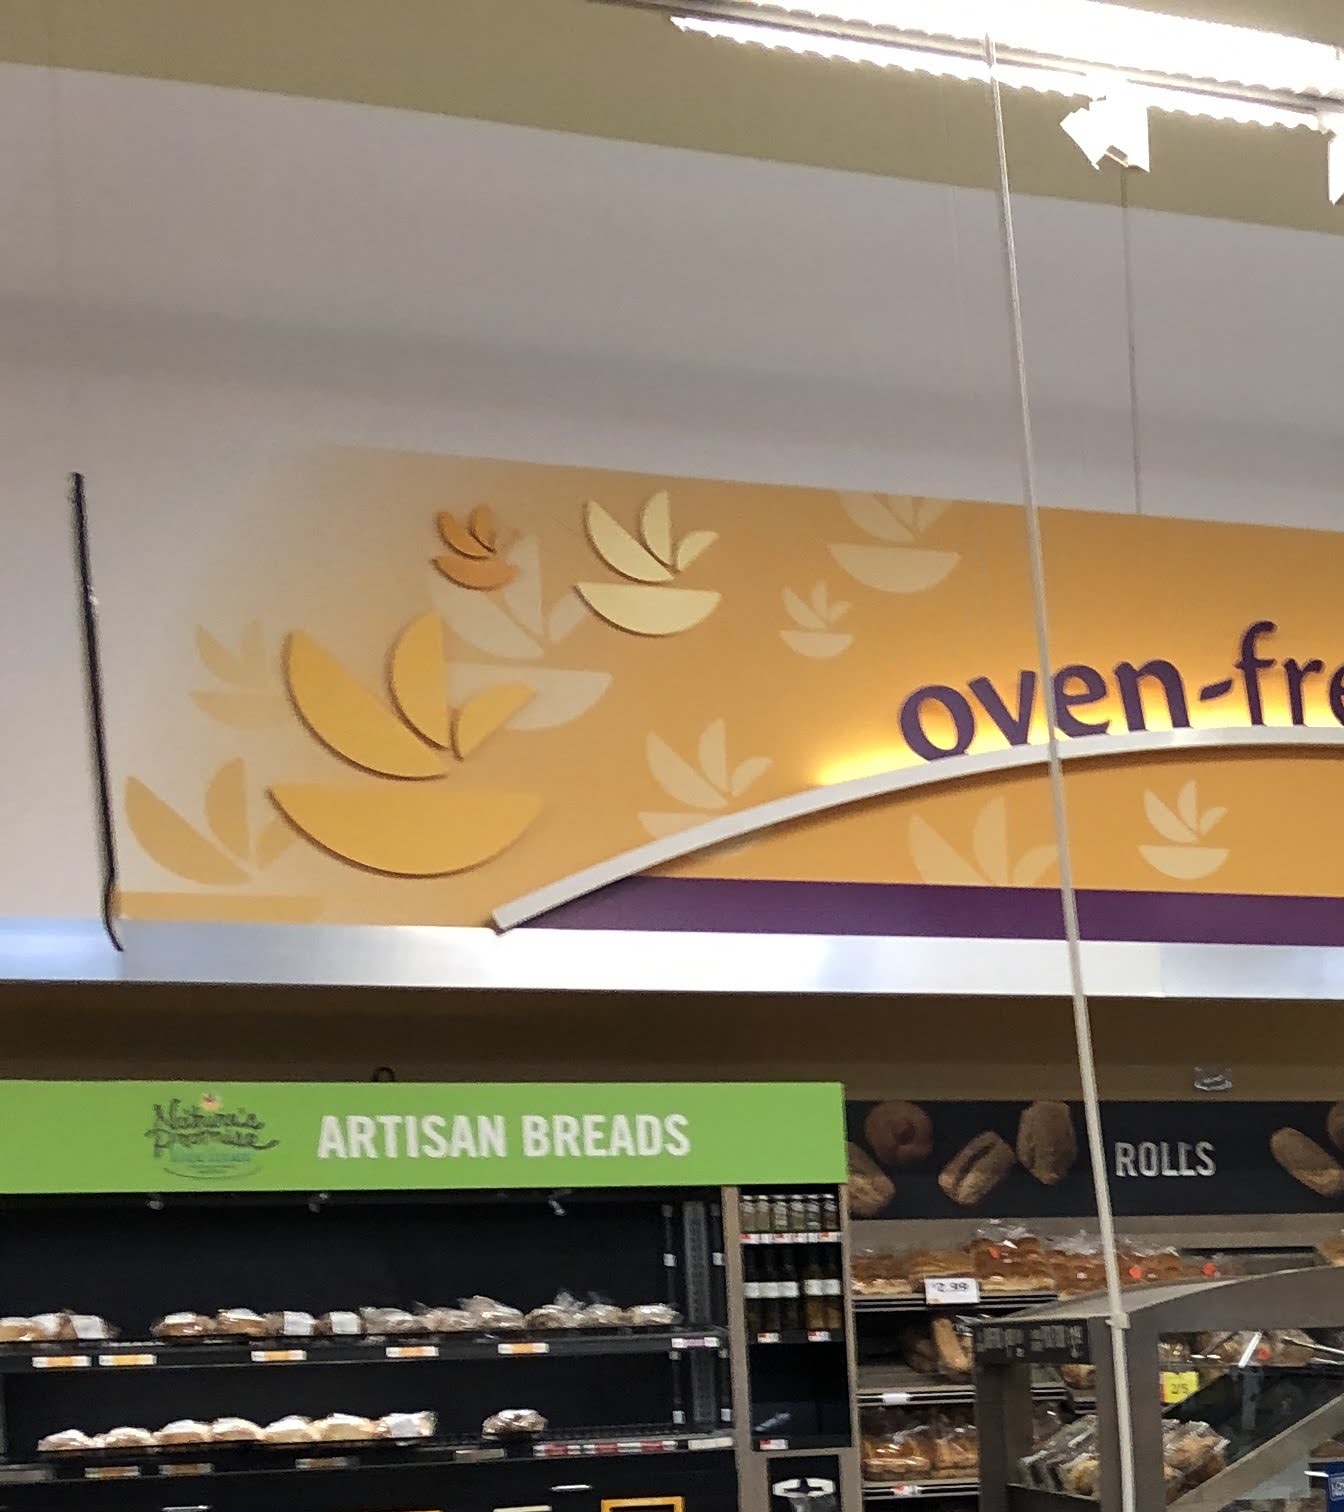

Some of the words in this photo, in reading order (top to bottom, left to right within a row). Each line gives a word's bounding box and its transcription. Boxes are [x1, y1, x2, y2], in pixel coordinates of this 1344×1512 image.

[317, 1114, 507, 1159] ARTISAN
[521, 1113, 691, 1158] BREADS
[1114, 1141, 1217, 1177] ROLLS
